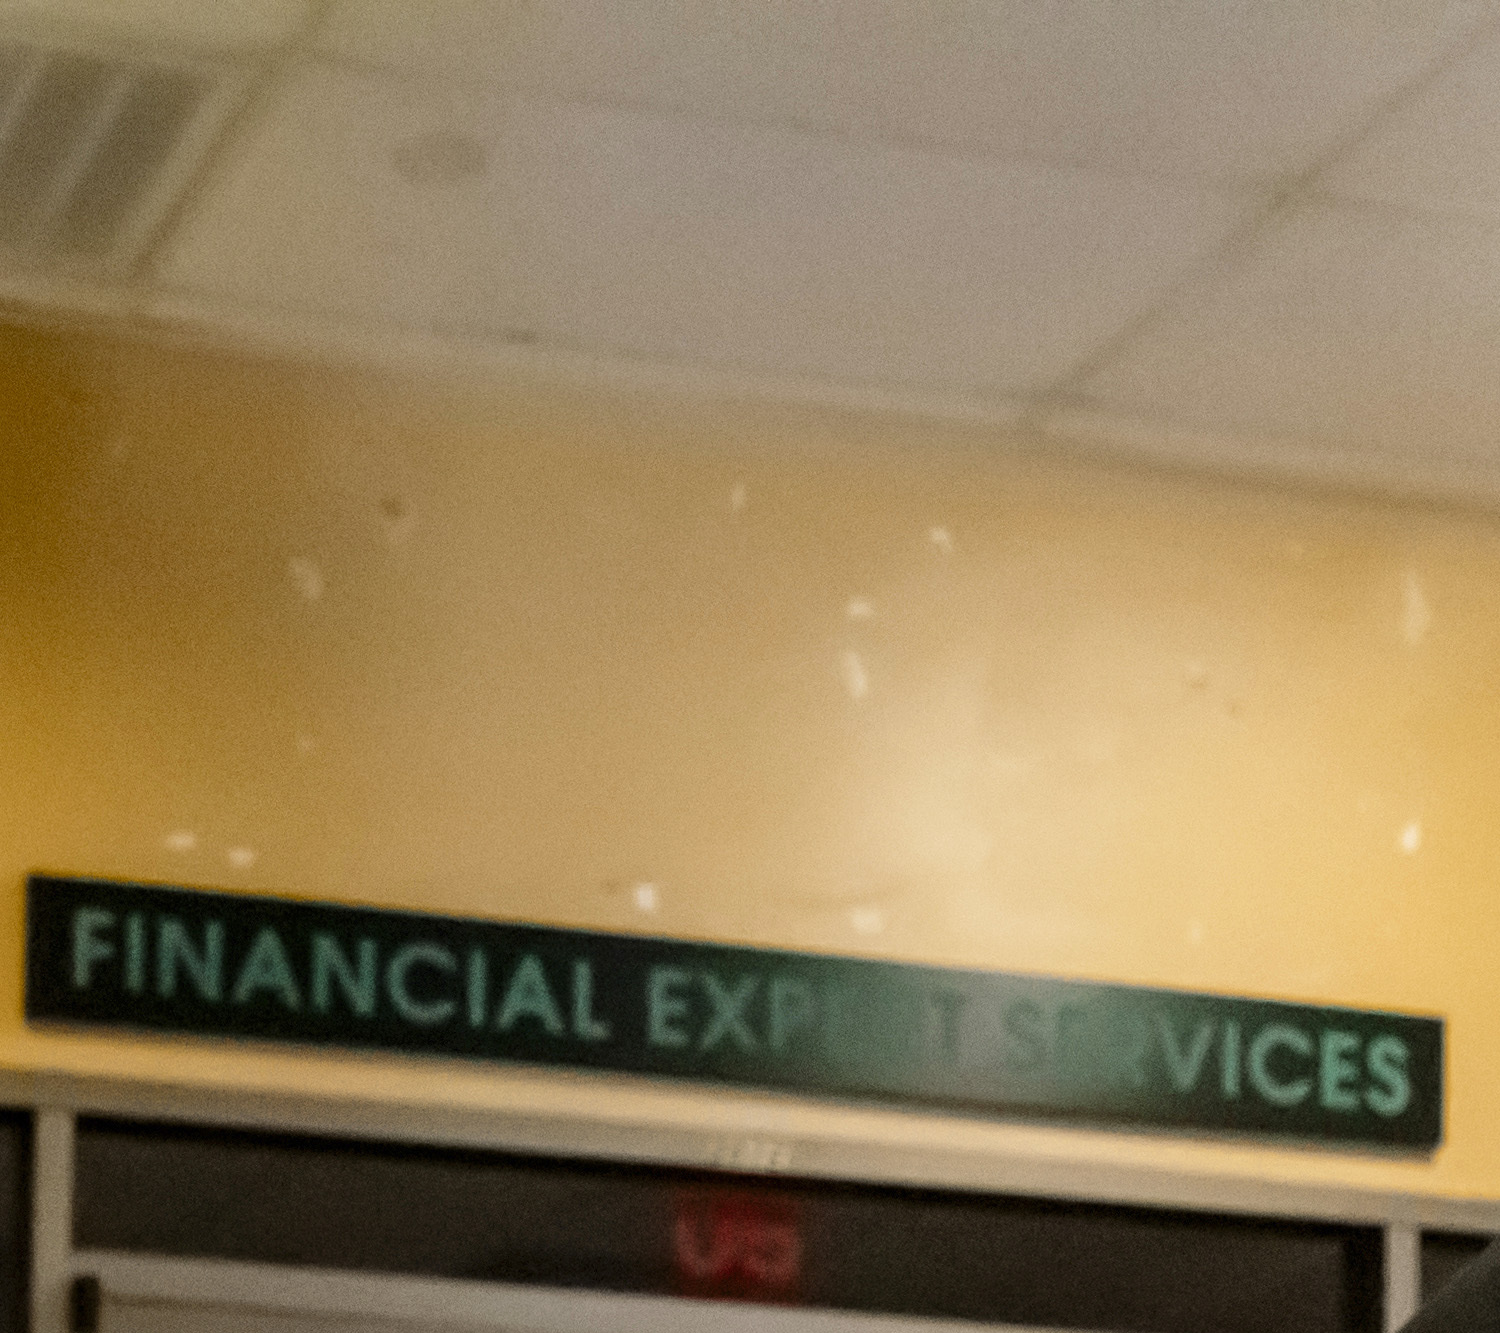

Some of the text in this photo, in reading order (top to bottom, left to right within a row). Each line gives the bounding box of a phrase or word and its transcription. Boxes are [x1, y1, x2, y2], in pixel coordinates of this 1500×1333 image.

[70, 905, 1413, 1117] FINANCIAL EXPT SVICES
